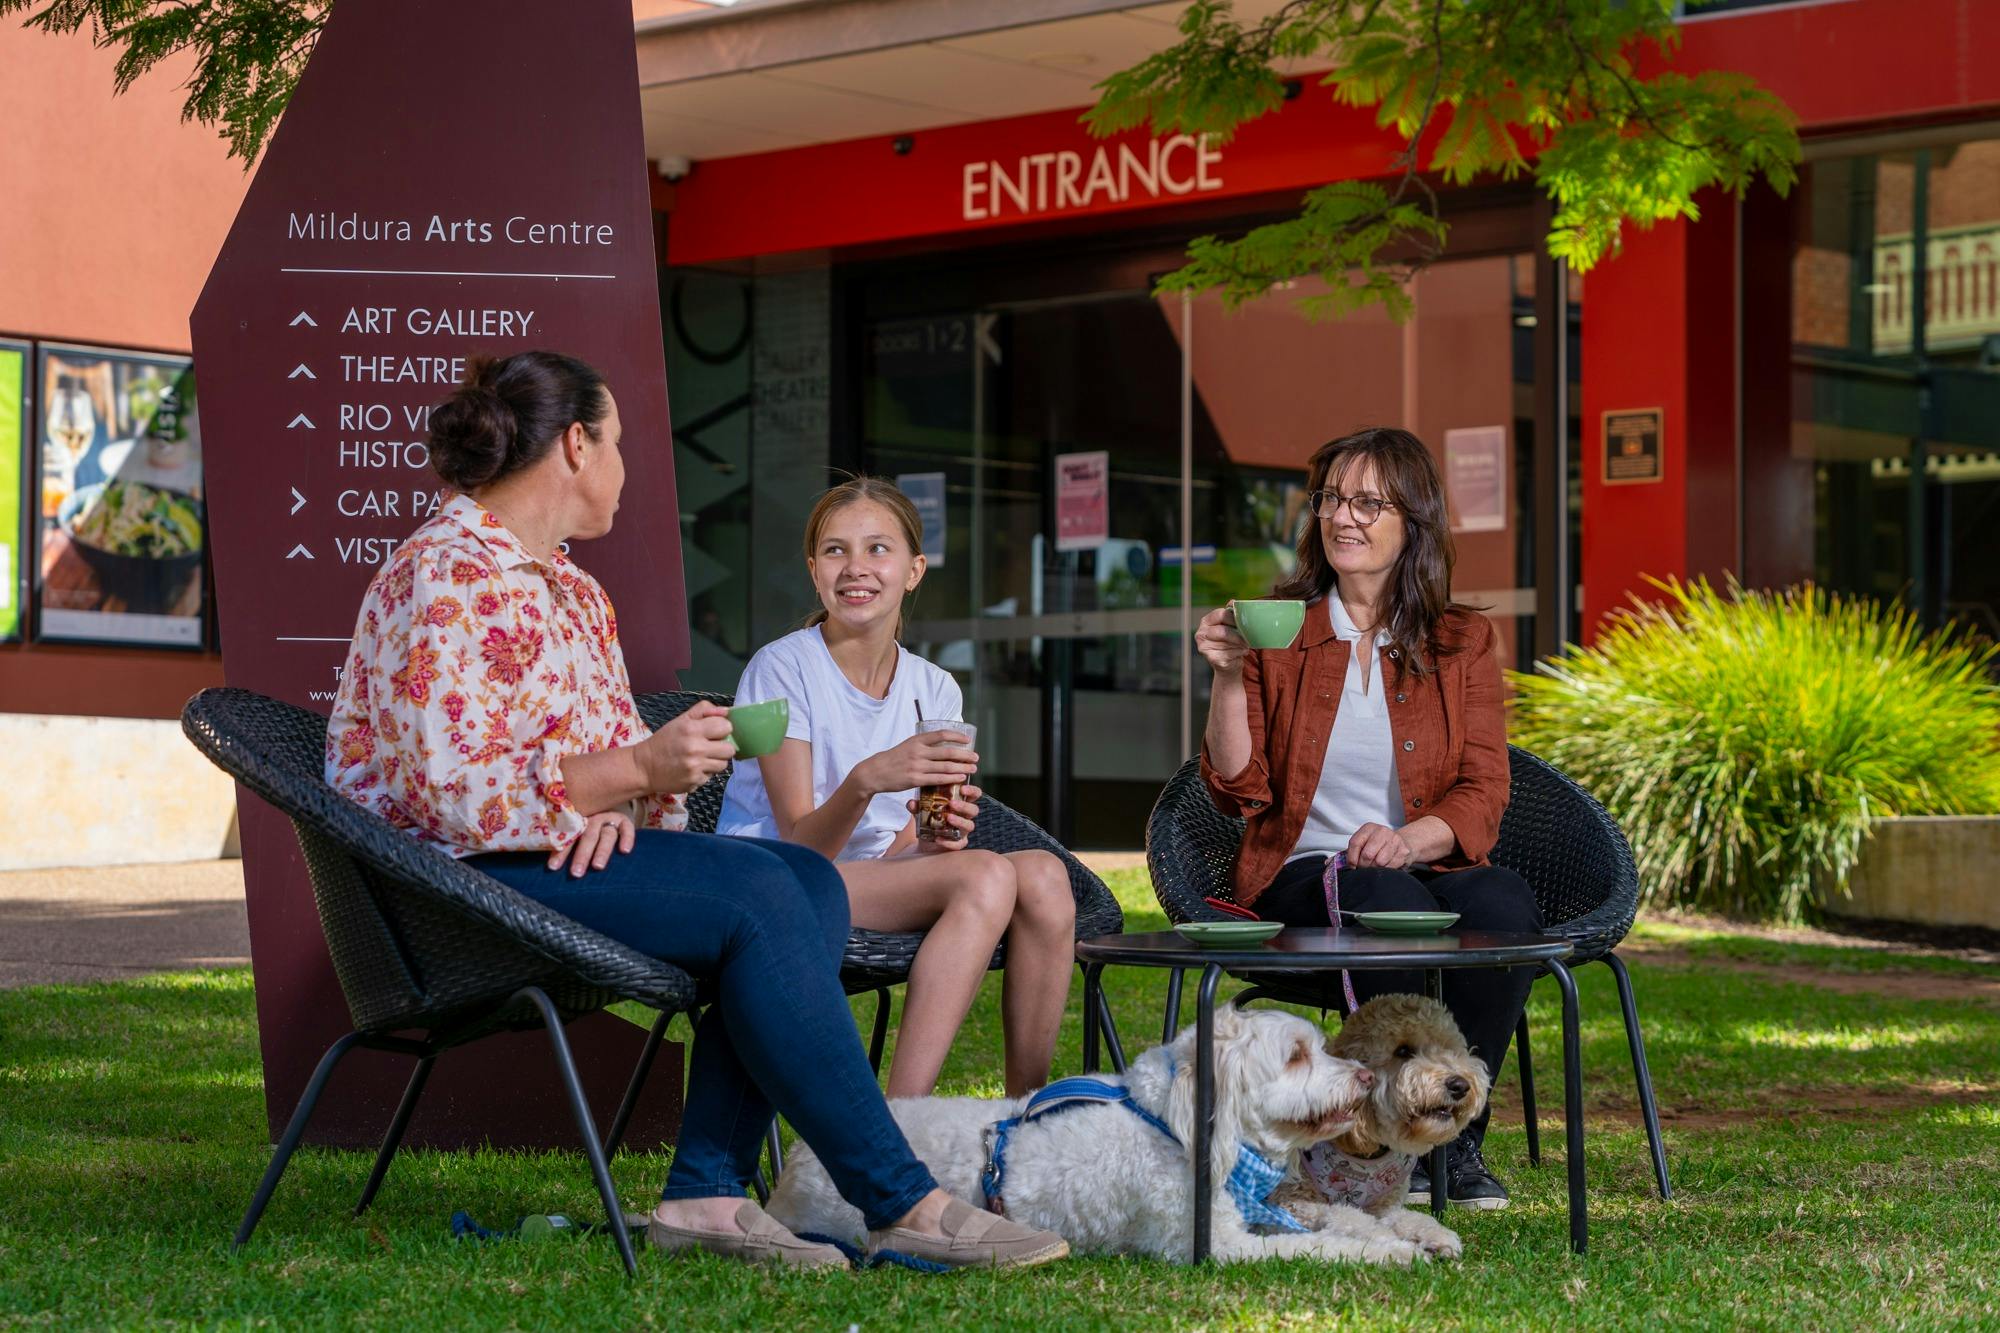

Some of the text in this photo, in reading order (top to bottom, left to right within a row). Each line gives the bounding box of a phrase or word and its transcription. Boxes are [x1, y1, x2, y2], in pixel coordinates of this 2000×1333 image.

[963, 132, 1223, 221] ENTRANCE
[288, 212, 614, 245] Mildura Arts Centre
[340, 307, 535, 337] ART GALLERY
[340, 355, 466, 384] THEATRE
[340, 404, 442, 432] RIO VI
[340, 441, 430, 469] HISTO
[337, 489, 400, 517] CAR
[334, 537, 407, 564] VIST
